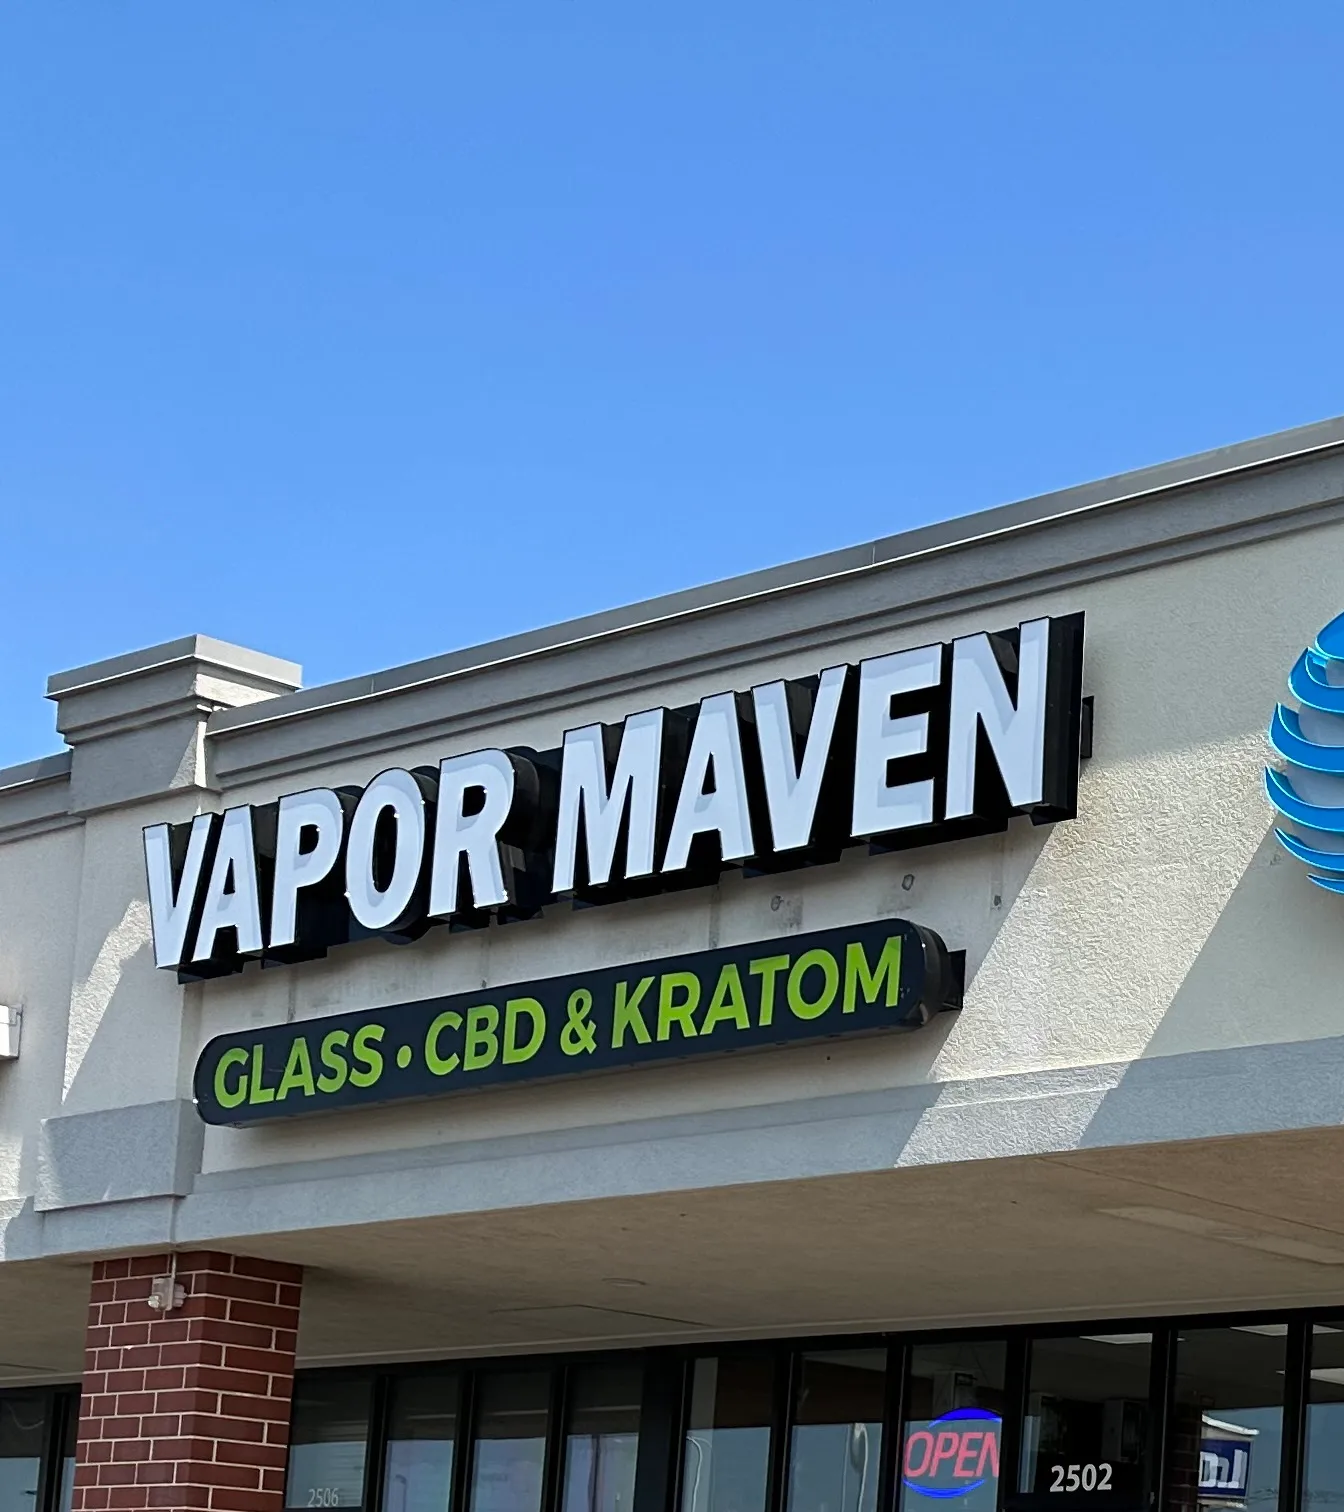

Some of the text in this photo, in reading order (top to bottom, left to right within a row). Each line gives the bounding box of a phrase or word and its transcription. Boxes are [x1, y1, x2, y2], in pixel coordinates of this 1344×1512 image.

[142, 615, 1056, 971] VAPOR MAVEN
[212, 934, 906, 1110] GLASS CBD & KRATOM
[904, 1431, 1000, 1478] OPEN
[1049, 1462, 1113, 1493] 2502
[307, 1487, 339, 1508] 2506
